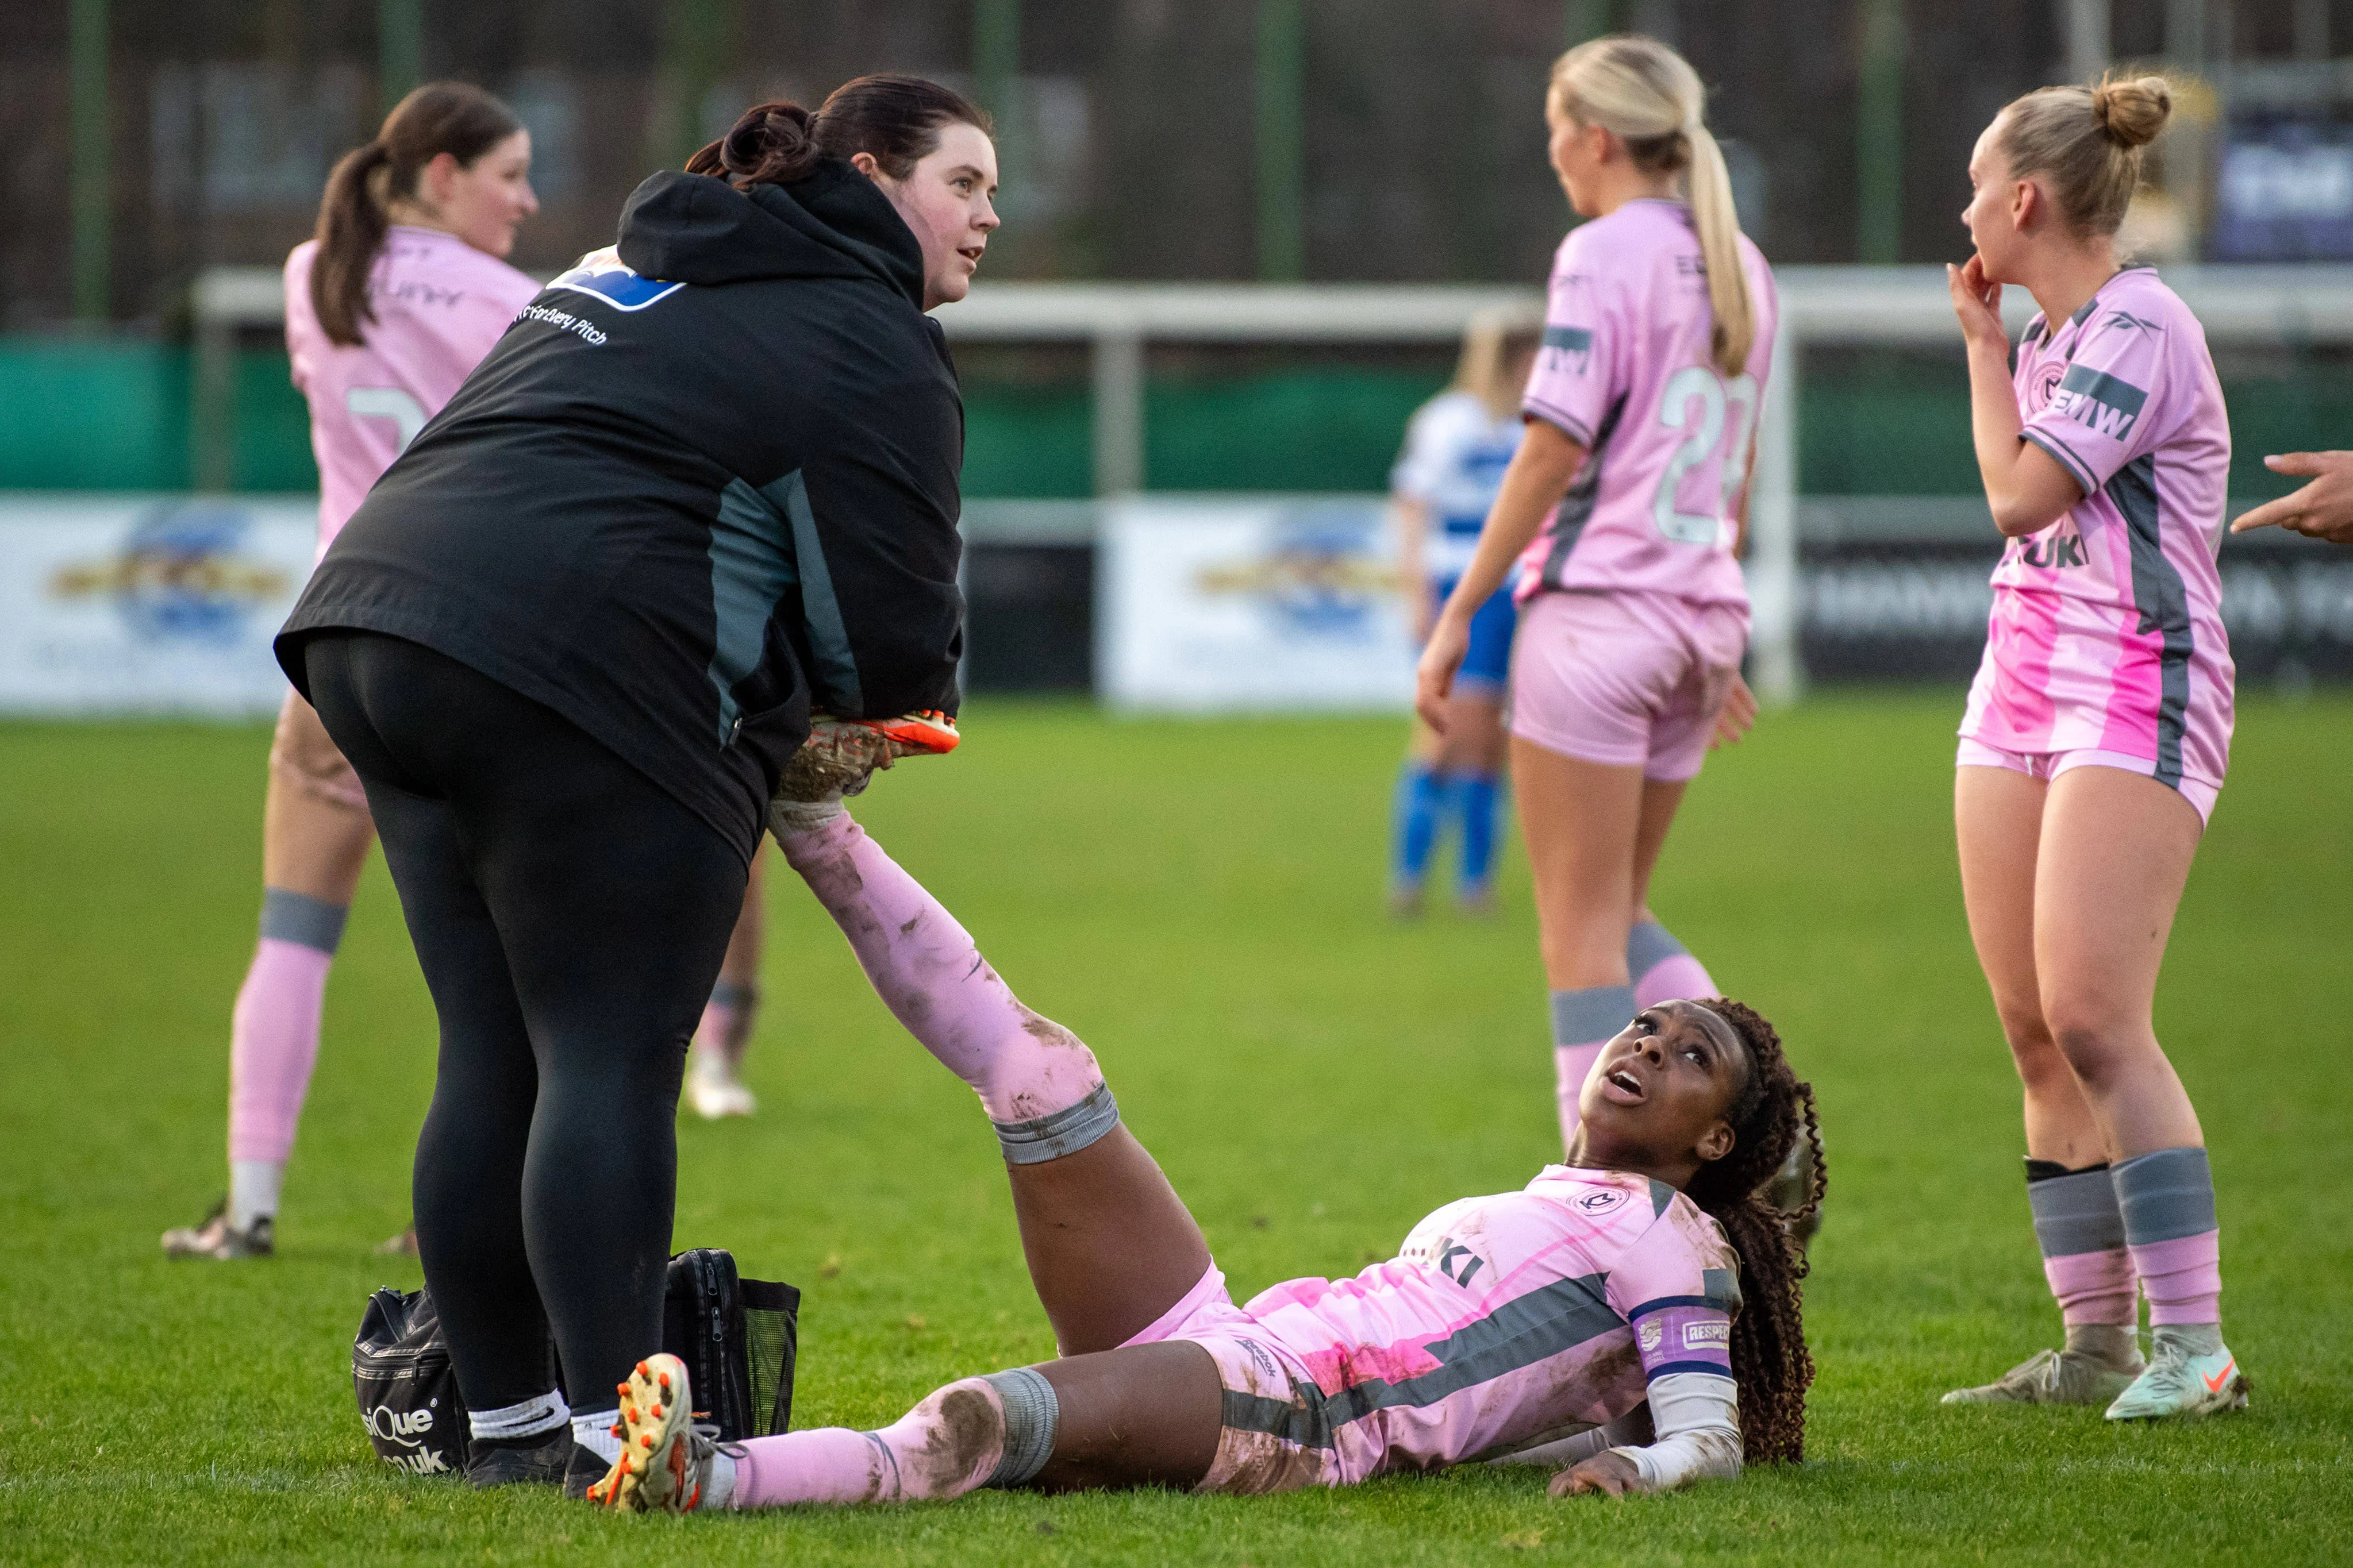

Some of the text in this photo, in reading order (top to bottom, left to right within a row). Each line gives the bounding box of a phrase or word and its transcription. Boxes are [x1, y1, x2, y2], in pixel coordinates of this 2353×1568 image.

[571, 319, 607, 345] Pitch
[2050, 388, 2135, 438] EMW
[1689, 1325, 1729, 1341] RESPEC
[361, 1405, 433, 1447] siQue
